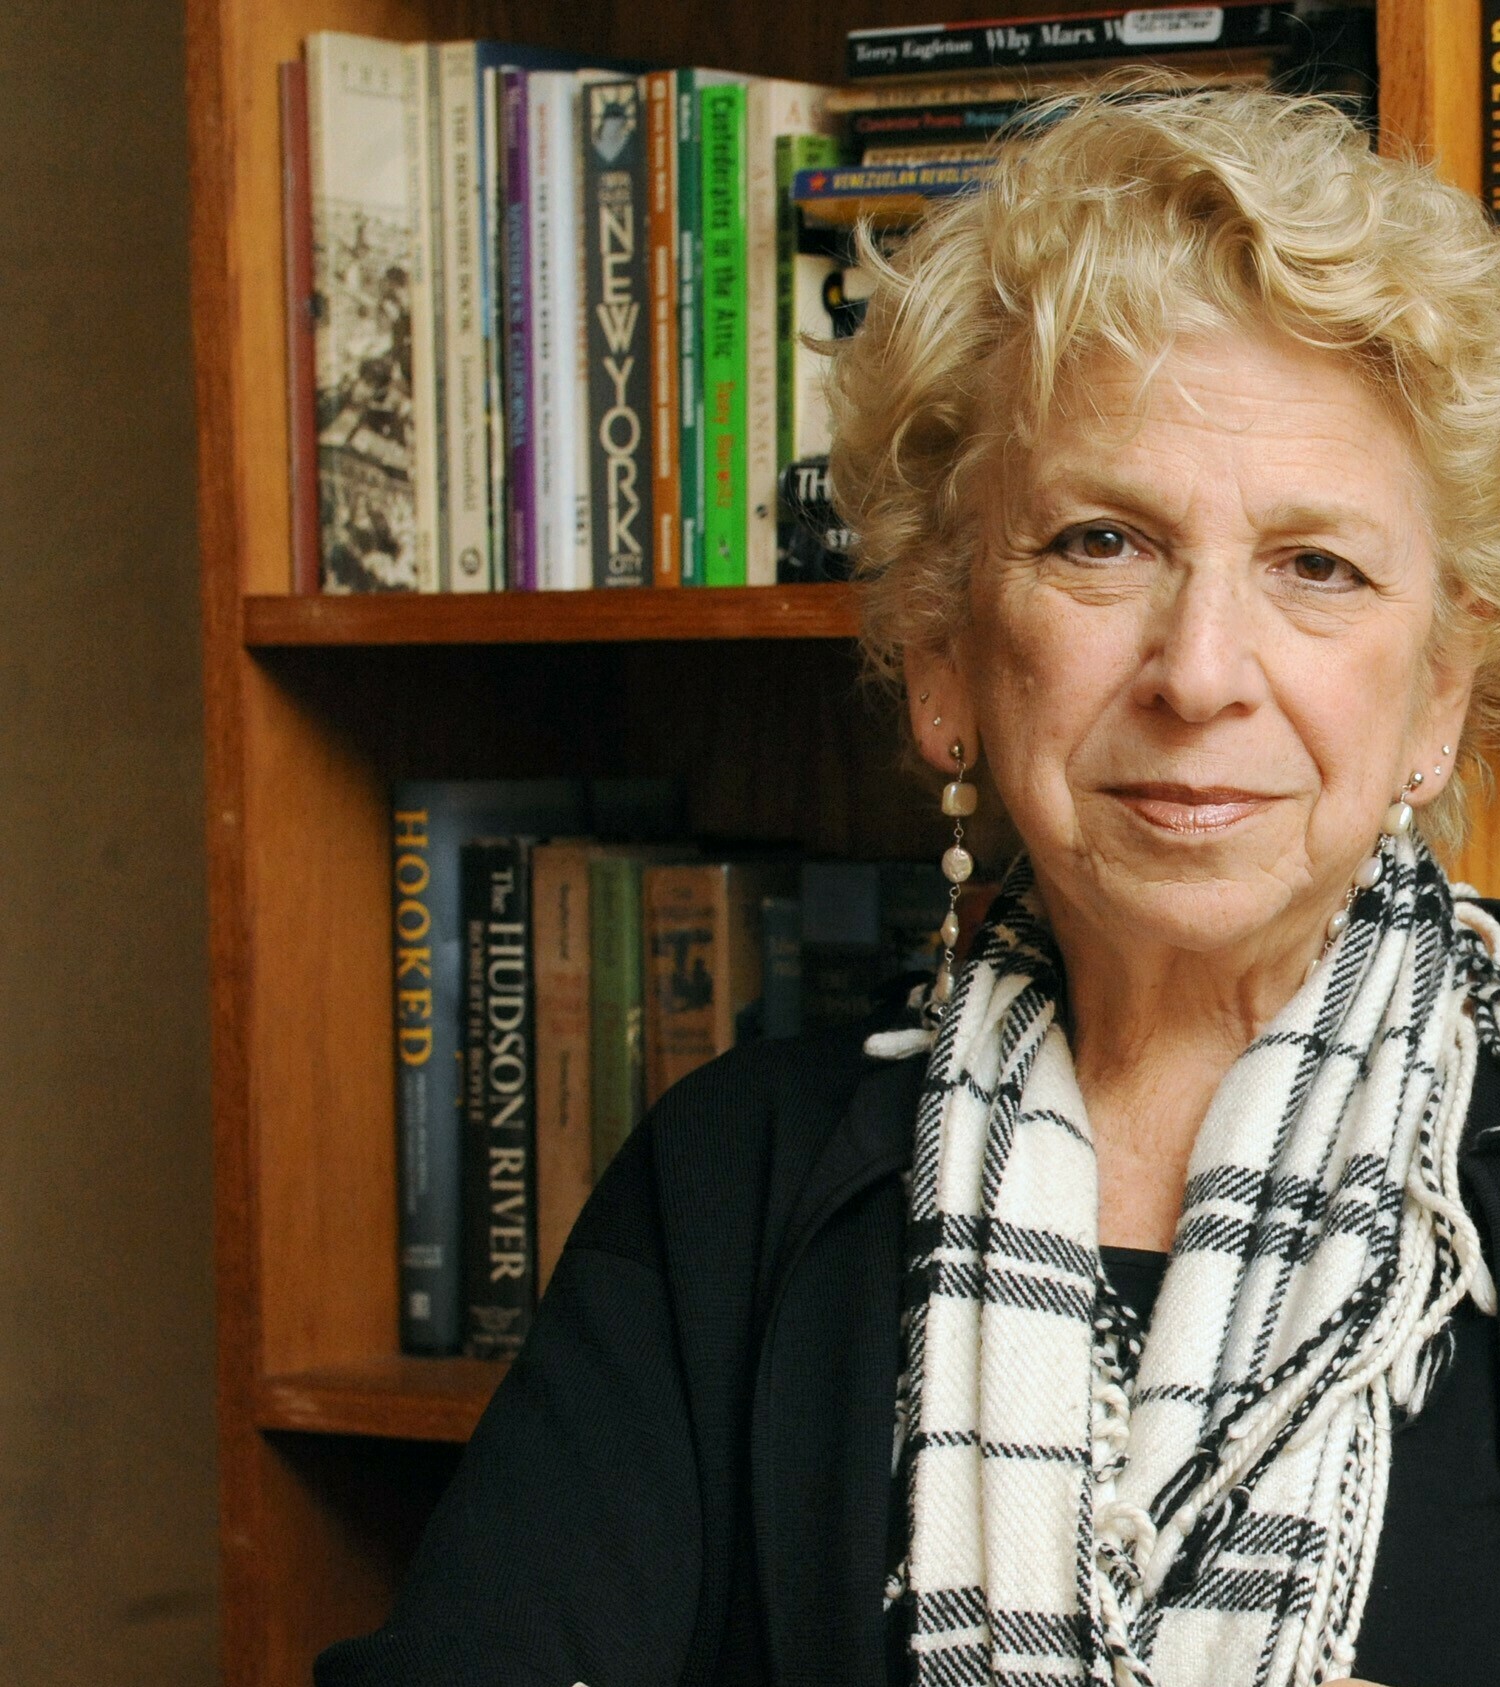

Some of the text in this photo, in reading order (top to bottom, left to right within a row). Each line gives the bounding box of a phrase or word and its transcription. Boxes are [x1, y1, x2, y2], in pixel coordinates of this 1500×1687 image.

[901, 37, 973, 61] Eagleton
[985, 28, 1031, 57] Why
[1040, 23, 1097, 48] Marx
[710, 97, 737, 298] Confederates the
[394, 808, 434, 1068] HOOKED
[490, 867, 515, 915] The
[487, 921, 528, 1131] HUDSON
[488, 1146, 528, 1283] RIVER
